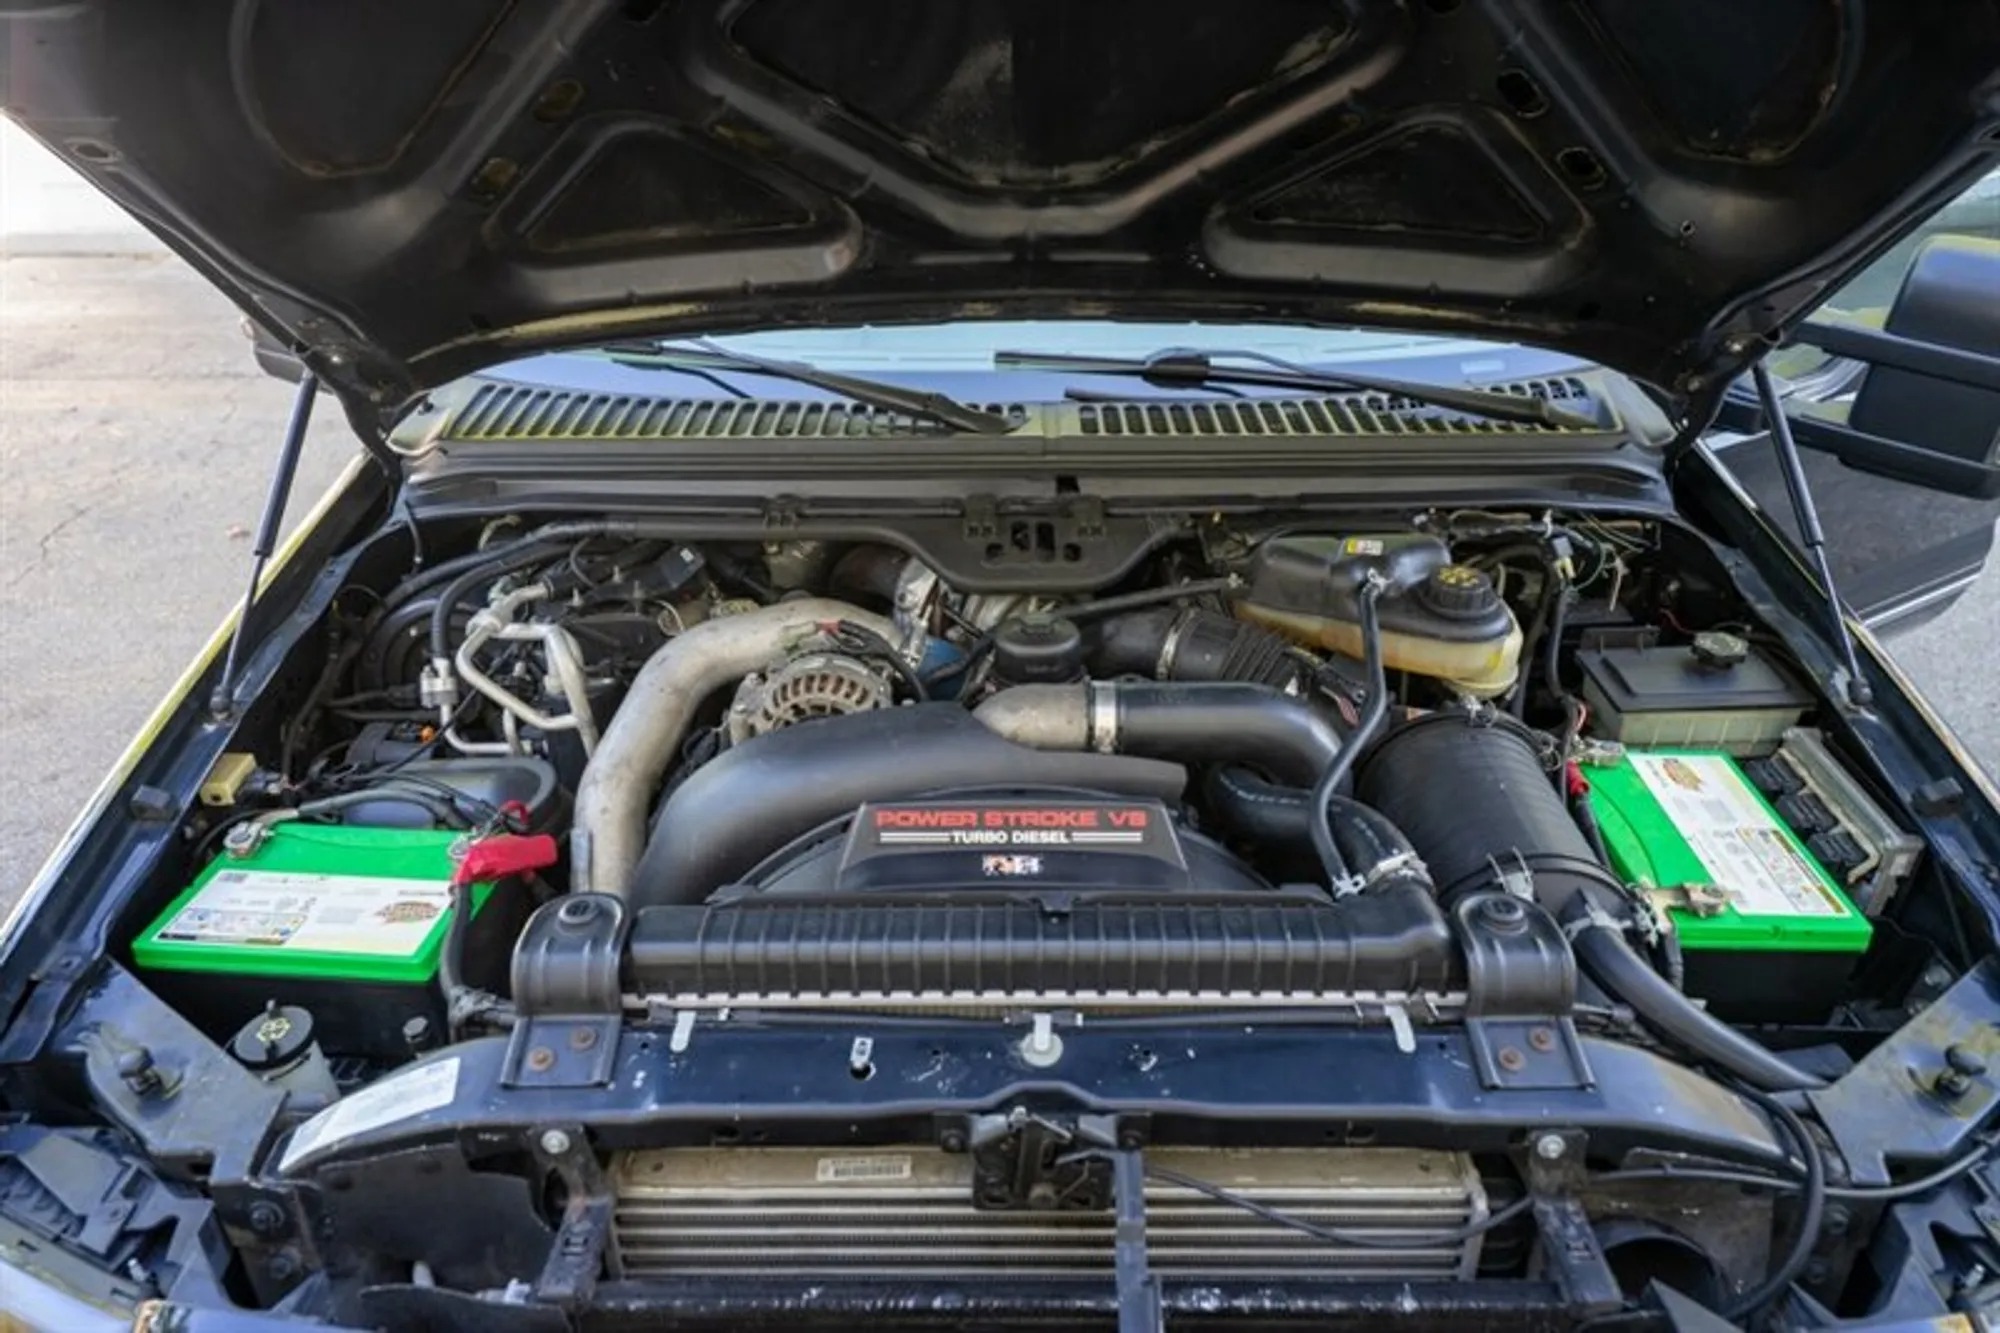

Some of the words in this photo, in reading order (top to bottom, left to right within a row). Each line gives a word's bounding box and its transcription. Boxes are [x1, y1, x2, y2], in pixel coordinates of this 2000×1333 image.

[876, 810, 977, 827] POWER
[984, 810, 1097, 827] STROKE
[952, 831, 1008, 843] TURBO
[1012, 831, 1071, 843] DIESEL
